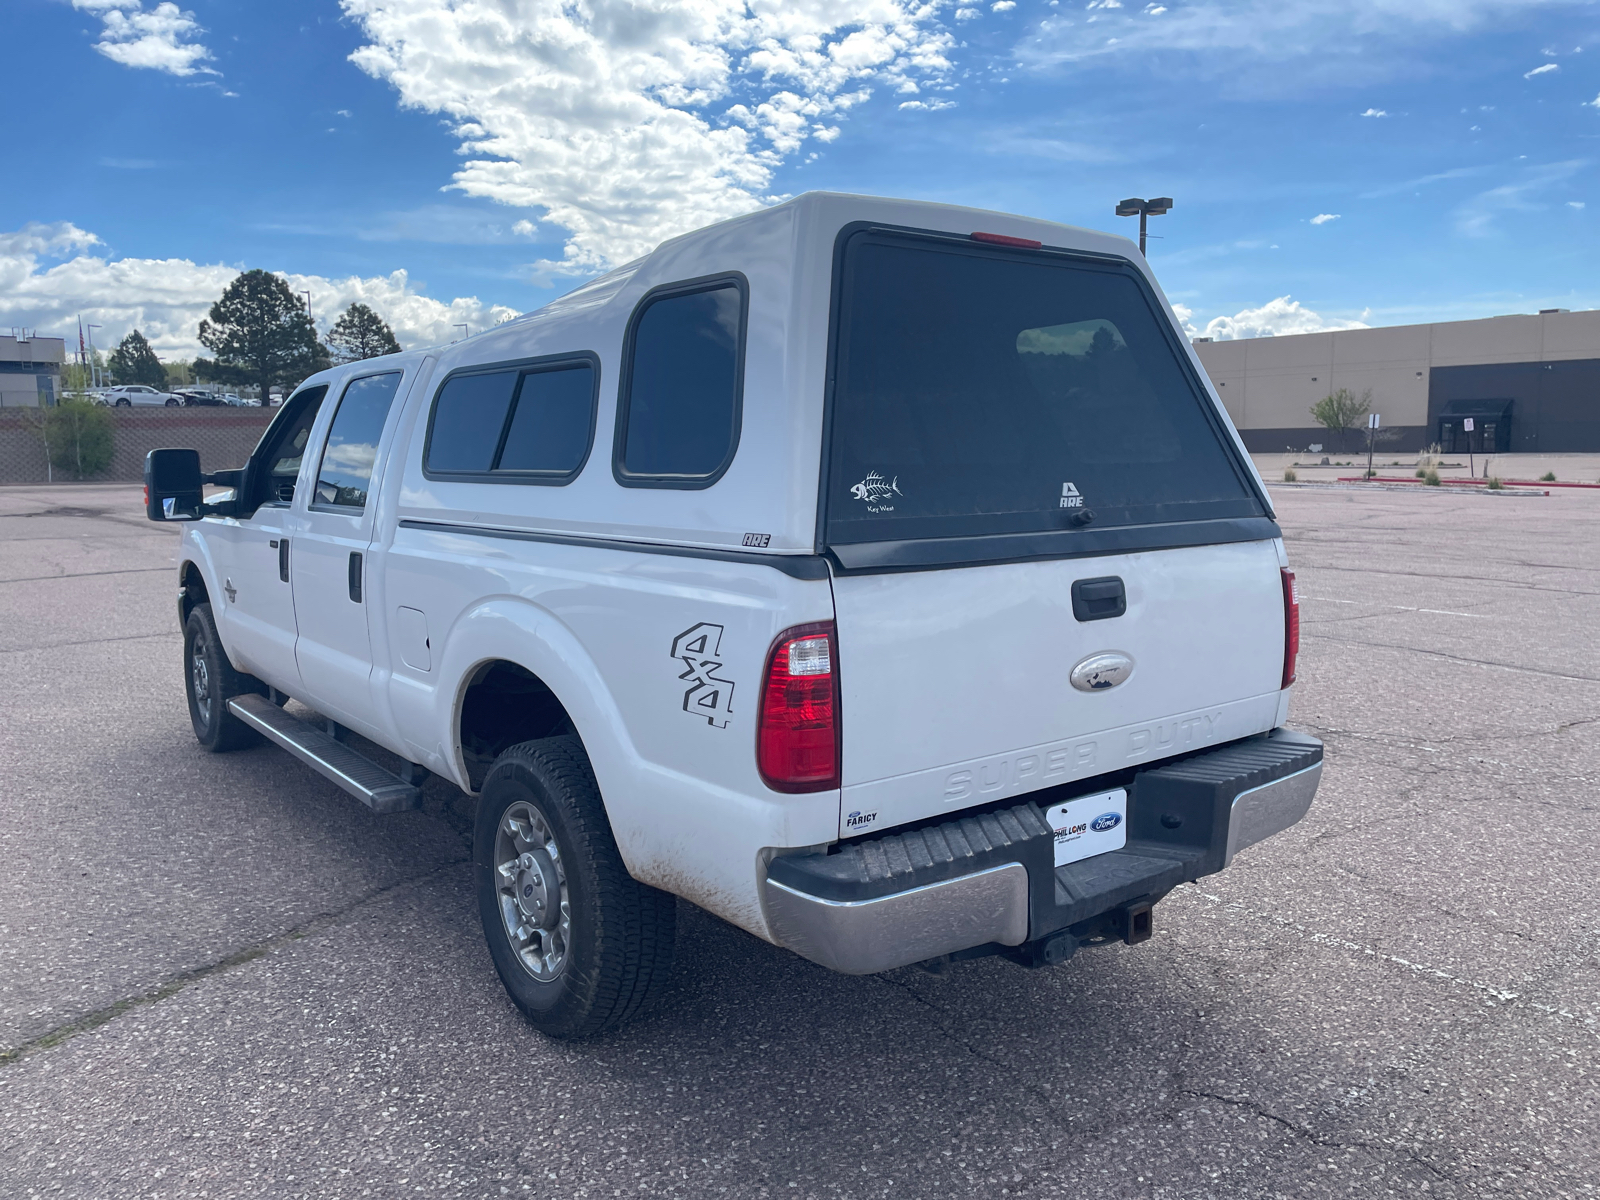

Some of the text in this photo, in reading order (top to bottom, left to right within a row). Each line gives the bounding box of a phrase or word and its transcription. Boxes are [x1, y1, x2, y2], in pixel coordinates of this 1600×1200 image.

[867, 504, 895, 514] Key West
[1059, 496, 1084, 508] ARE
[742, 532, 771, 548] ARE
[943, 711, 1223, 802] SUPER DUTY
[846, 812, 877, 827] FARICY
[1093, 814, 1119, 831] Ford
[1068, 823, 1087, 835] LONG
